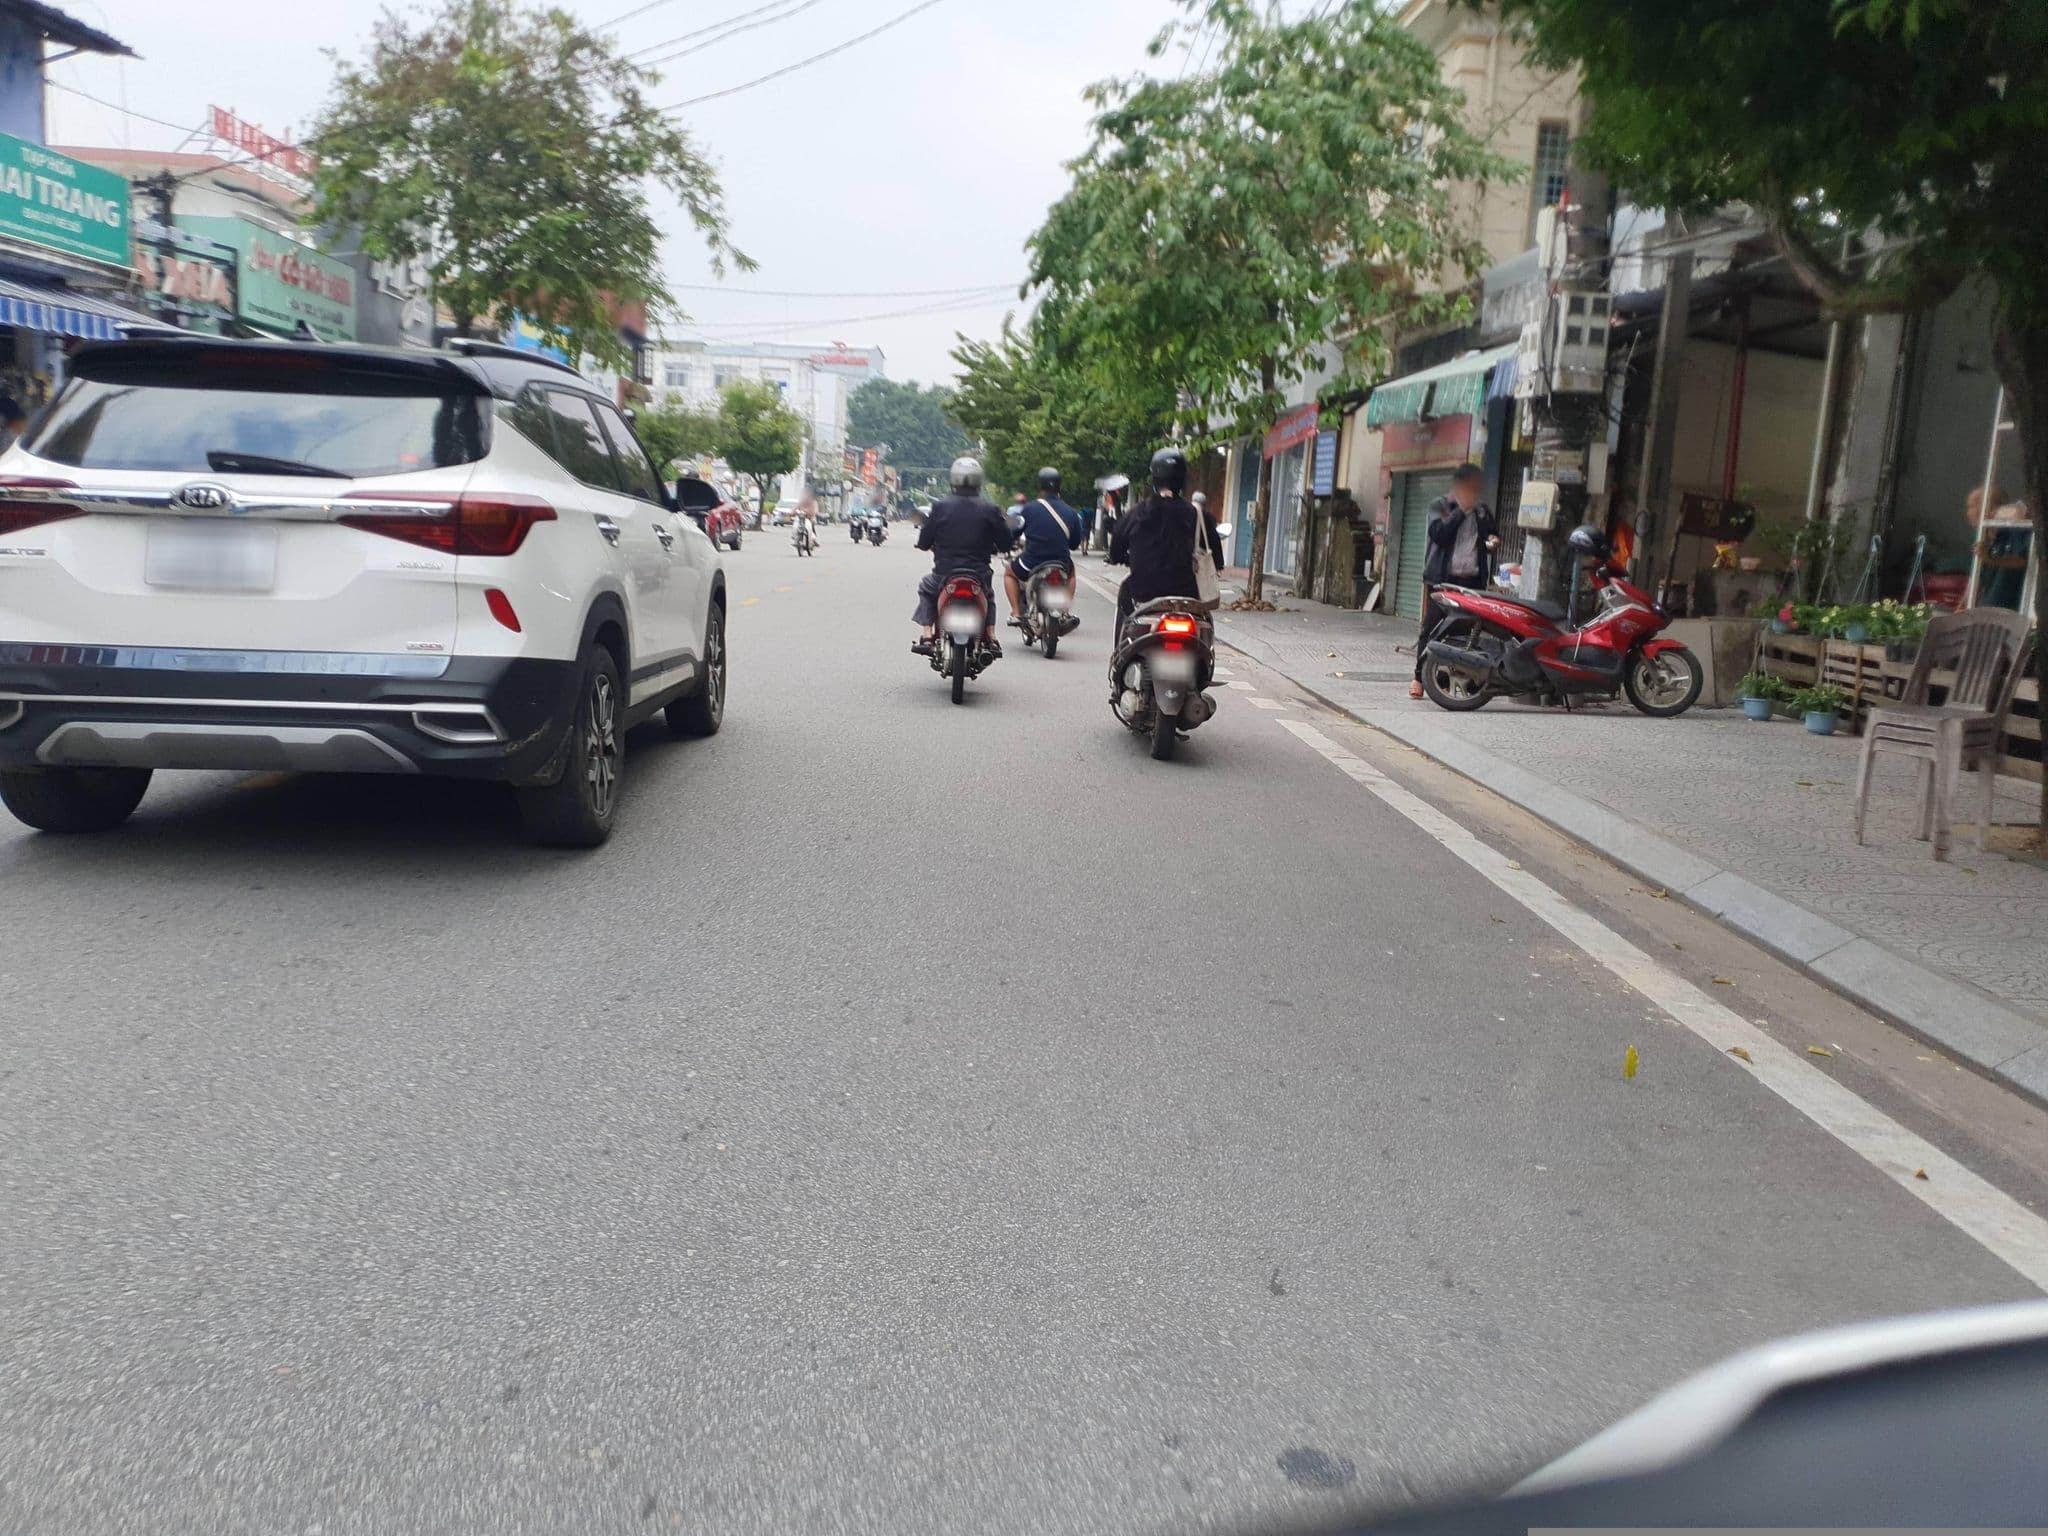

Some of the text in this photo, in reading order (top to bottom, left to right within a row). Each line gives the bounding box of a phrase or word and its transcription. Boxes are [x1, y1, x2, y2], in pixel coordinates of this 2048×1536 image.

[0, 163, 32, 200] AI
[34, 175, 120, 228] TRANG
[184, 487, 222, 506] KIA
